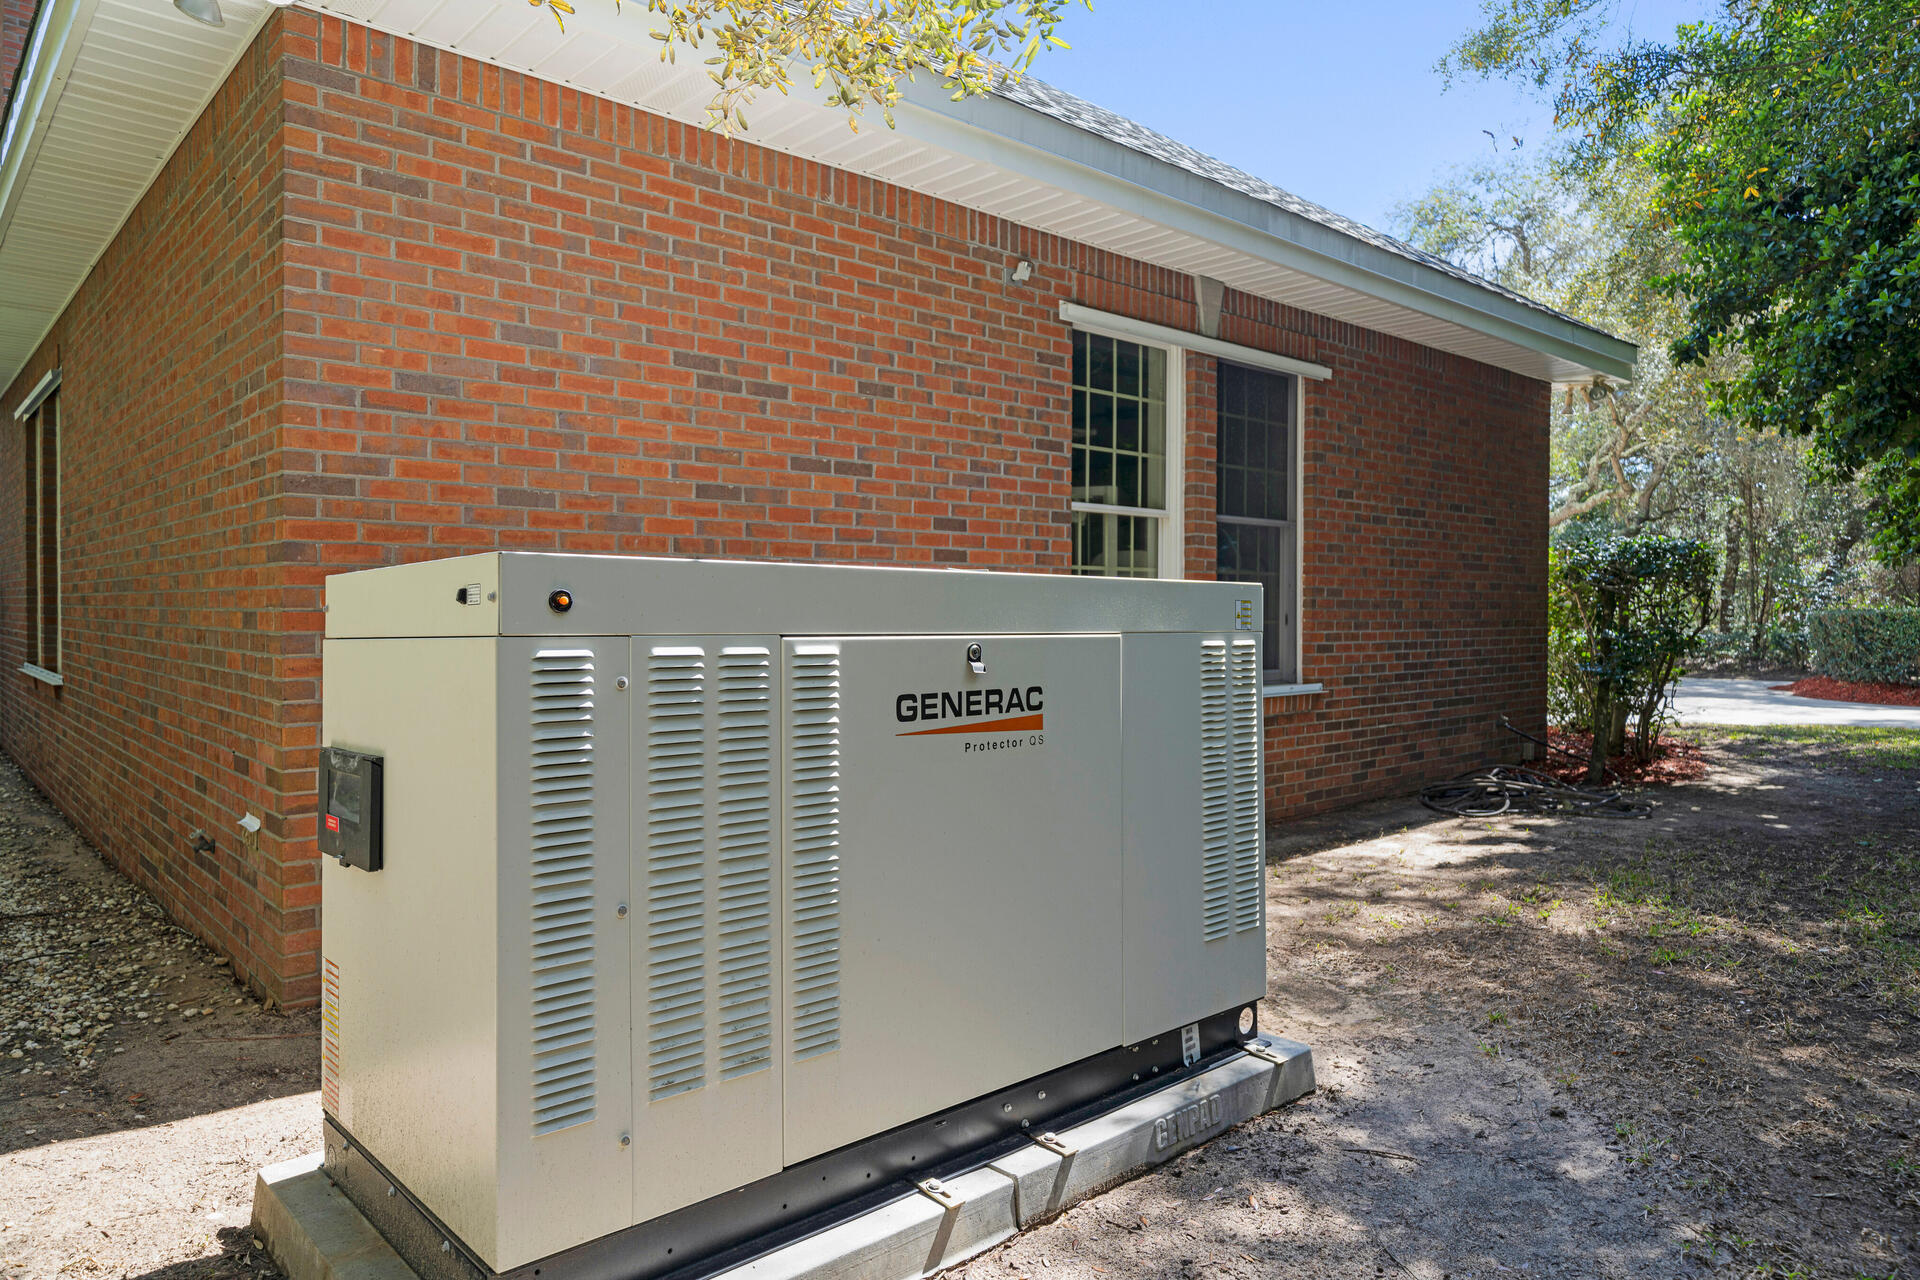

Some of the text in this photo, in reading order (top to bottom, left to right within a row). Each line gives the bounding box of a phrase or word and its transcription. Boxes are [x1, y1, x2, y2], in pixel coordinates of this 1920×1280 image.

[895, 686, 1044, 722] GENERAC
[964, 734, 1044, 753] Protector QS
